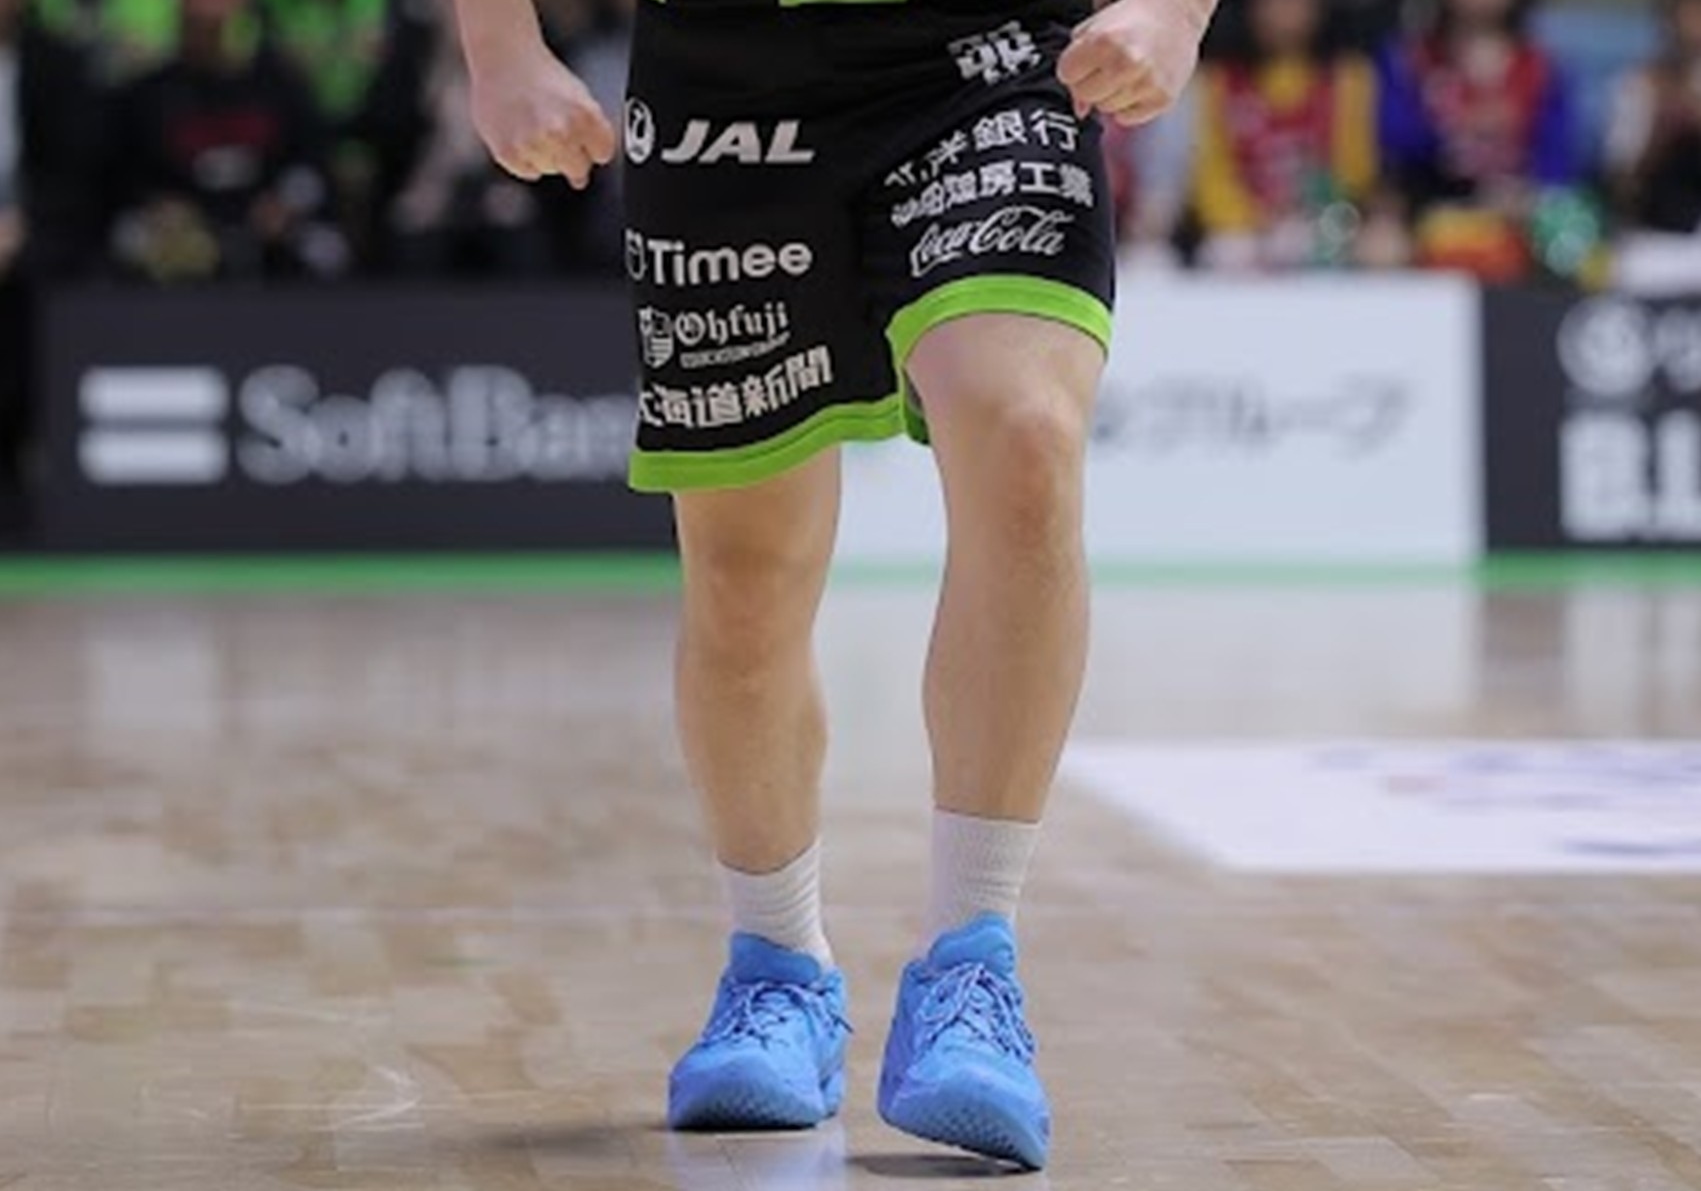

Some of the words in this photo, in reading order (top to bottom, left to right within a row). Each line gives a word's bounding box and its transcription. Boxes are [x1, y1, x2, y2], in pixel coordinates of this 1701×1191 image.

[661, 119, 815, 164] JAL
[647, 238, 814, 286] Timee
[675, 301, 789, 346] Ohfuji
[236, 364, 635, 483] SoftBan
